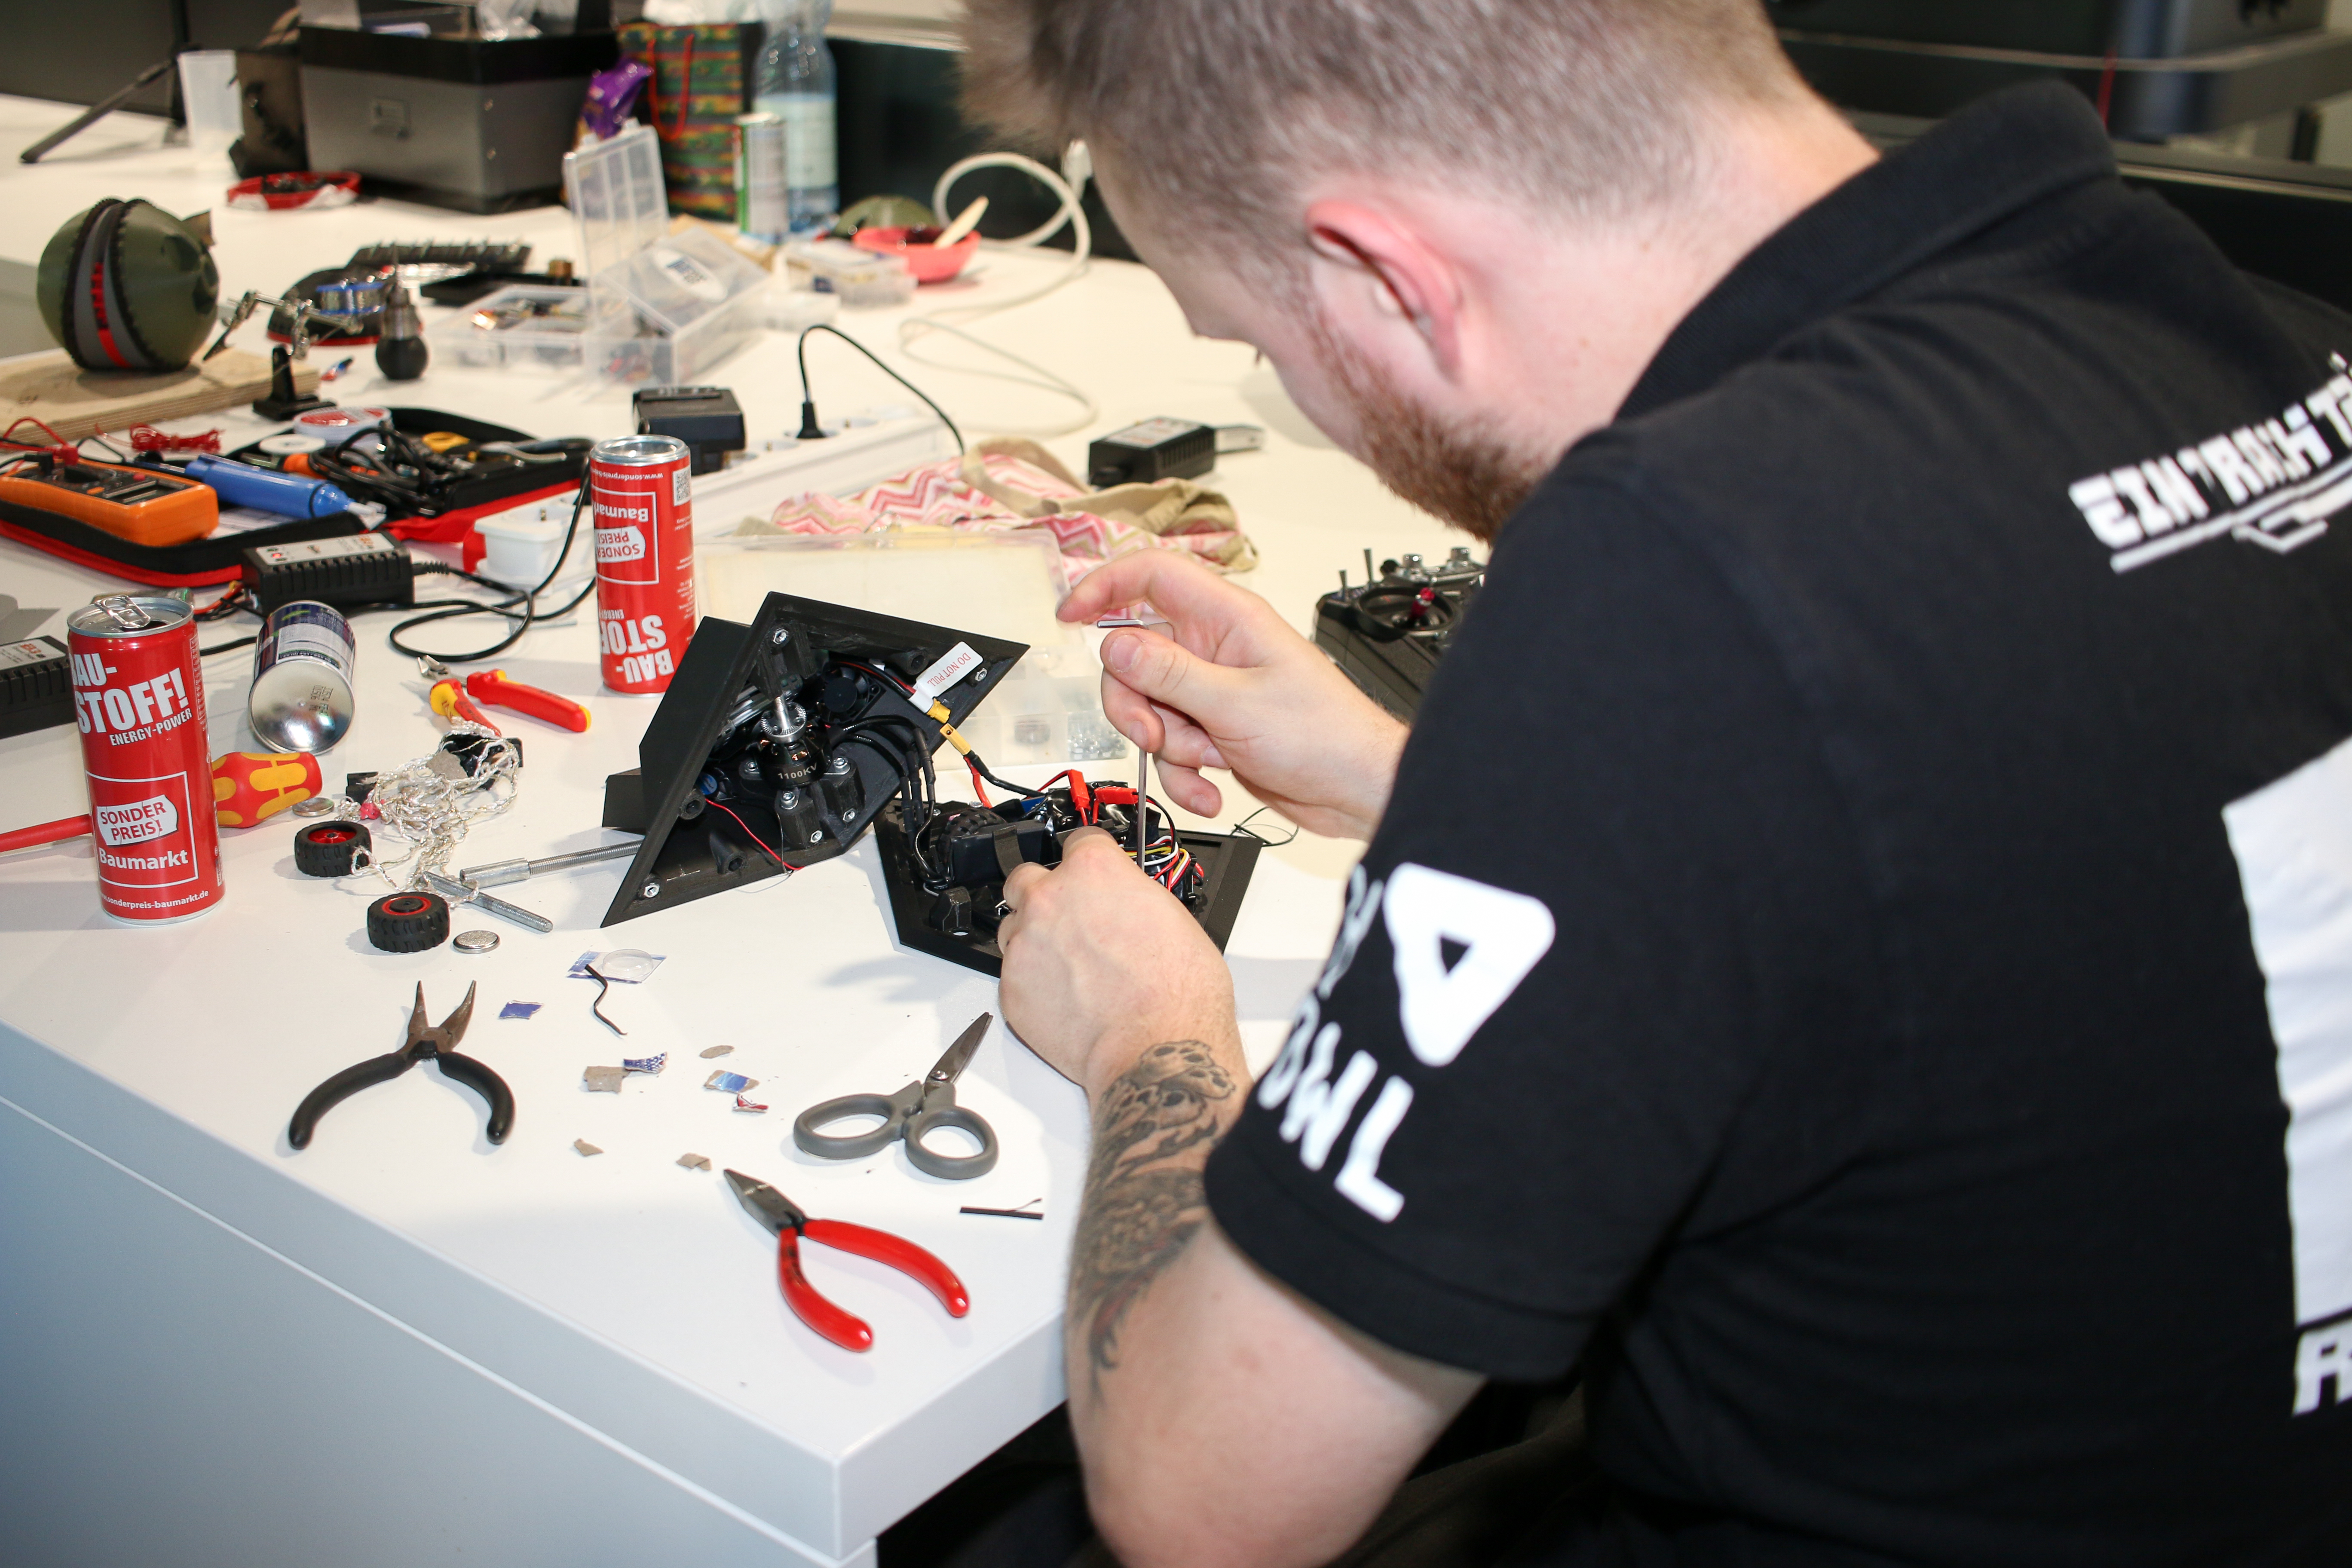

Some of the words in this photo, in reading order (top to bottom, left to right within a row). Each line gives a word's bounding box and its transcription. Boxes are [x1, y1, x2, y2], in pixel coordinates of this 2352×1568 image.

[597, 543, 641, 558] SONDER
[616, 648, 675, 684] BAU-
[957, 652, 972, 665] DO
[927, 672, 946, 687] PULL
[943, 662, 960, 678] NOT
[75, 667, 189, 734] STOFF!
[109, 708, 193, 747] ENERGY-POWER
[778, 763, 817, 780] 1100KV
[100, 801, 167, 825] SONDER
[110, 819, 163, 841] PREIS!
[98, 847, 189, 870] Baumarkt
